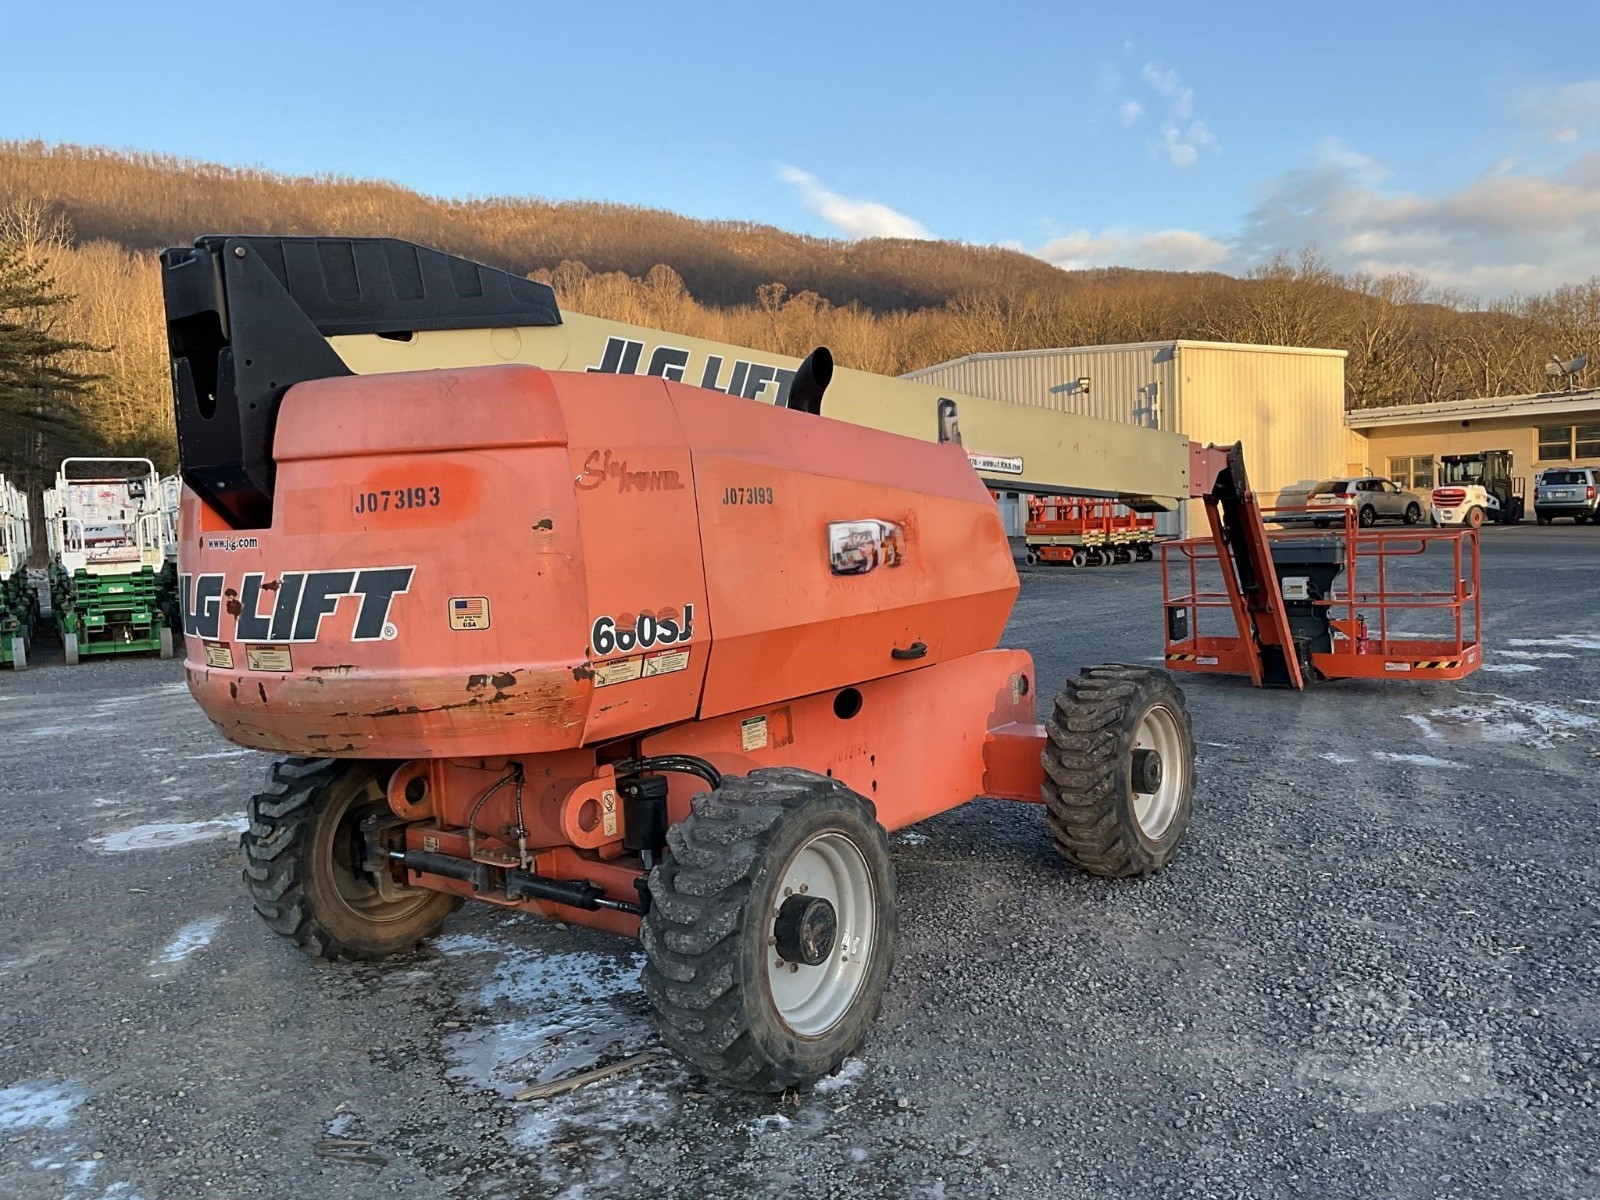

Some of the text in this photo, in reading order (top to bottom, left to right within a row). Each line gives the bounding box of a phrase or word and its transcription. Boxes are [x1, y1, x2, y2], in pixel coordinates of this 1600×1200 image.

[355, 486, 441, 514] J073193
[723, 487, 774, 505] J073193
[208, 536, 258, 551] www.jg.com
